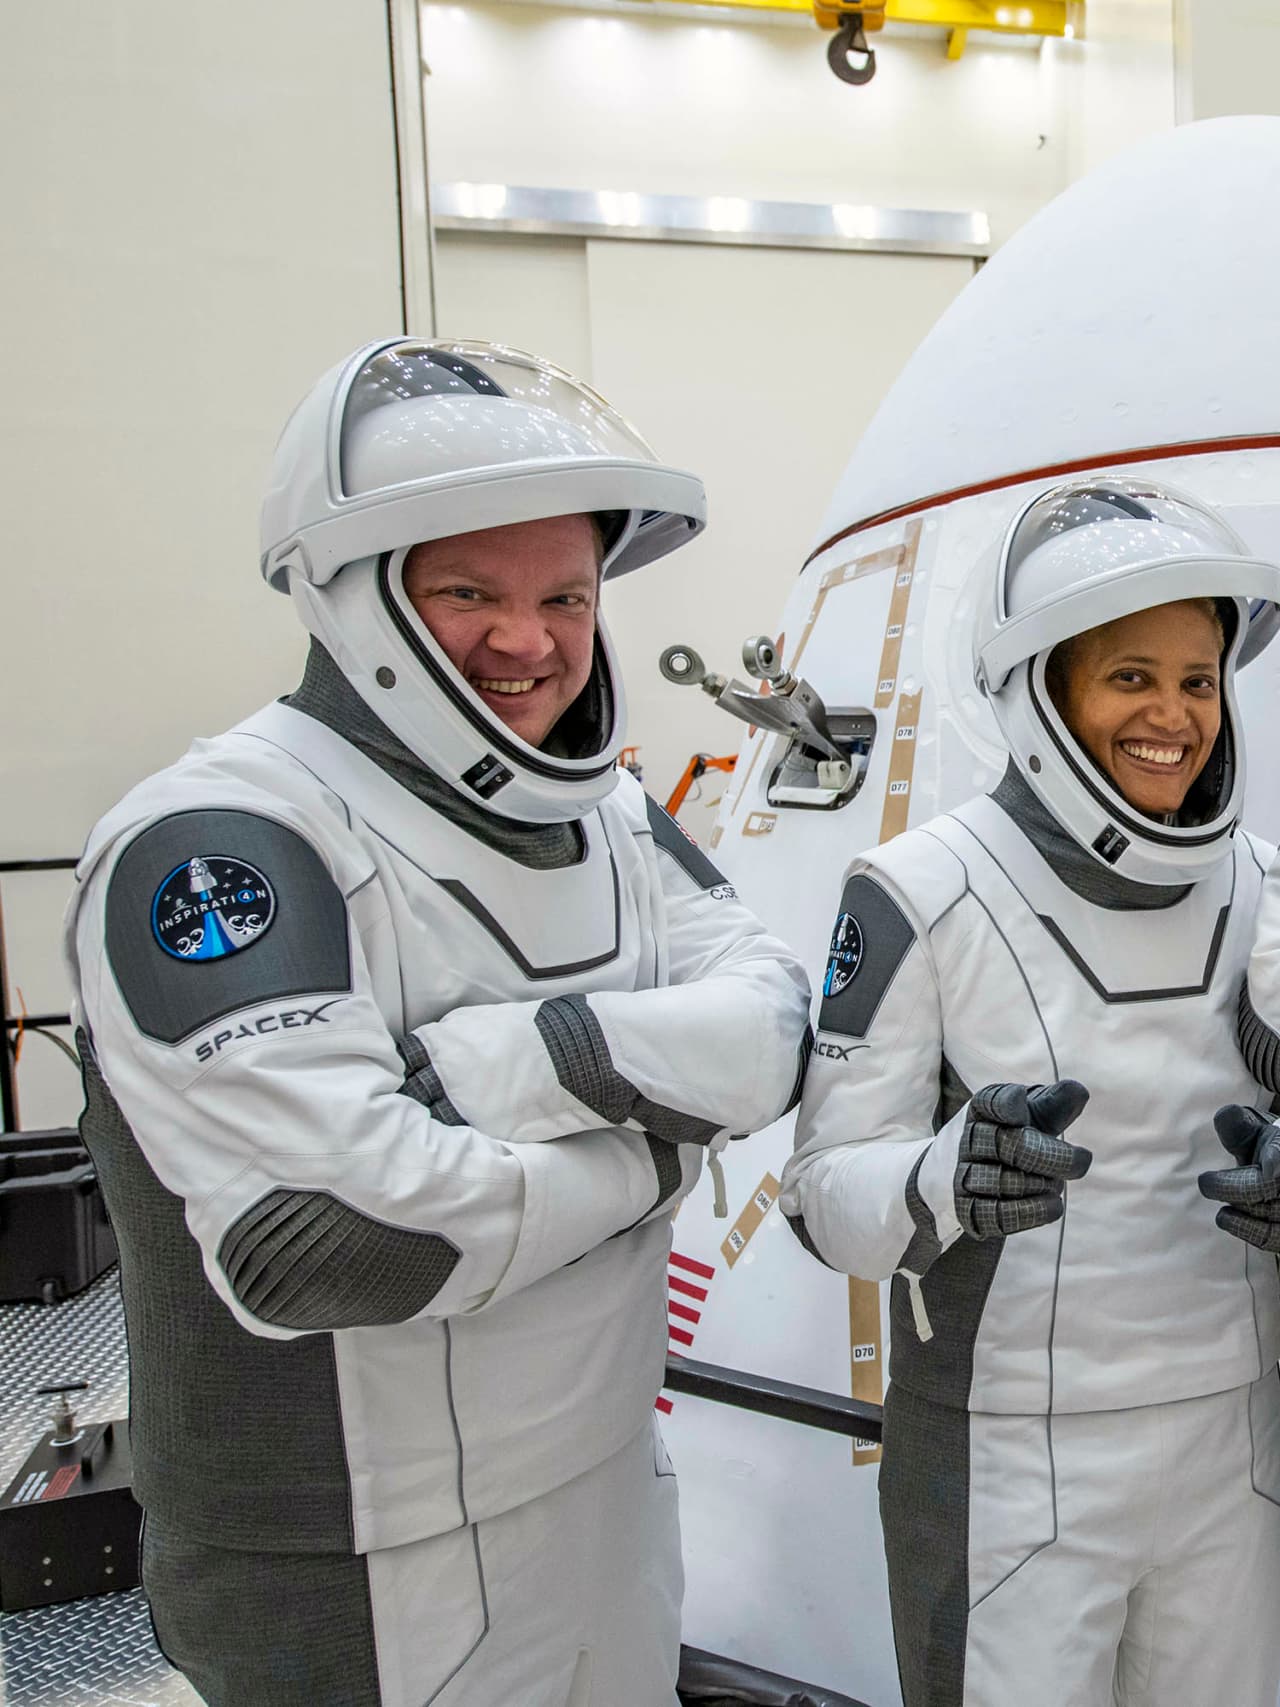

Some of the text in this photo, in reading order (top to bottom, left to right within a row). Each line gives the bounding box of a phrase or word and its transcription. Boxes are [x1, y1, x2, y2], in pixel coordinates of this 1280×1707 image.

[897, 728, 912, 737] D78
[891, 783, 907, 792] D77
[195, 998, 349, 1062] SPACEX
[855, 1346, 874, 1358] D70
